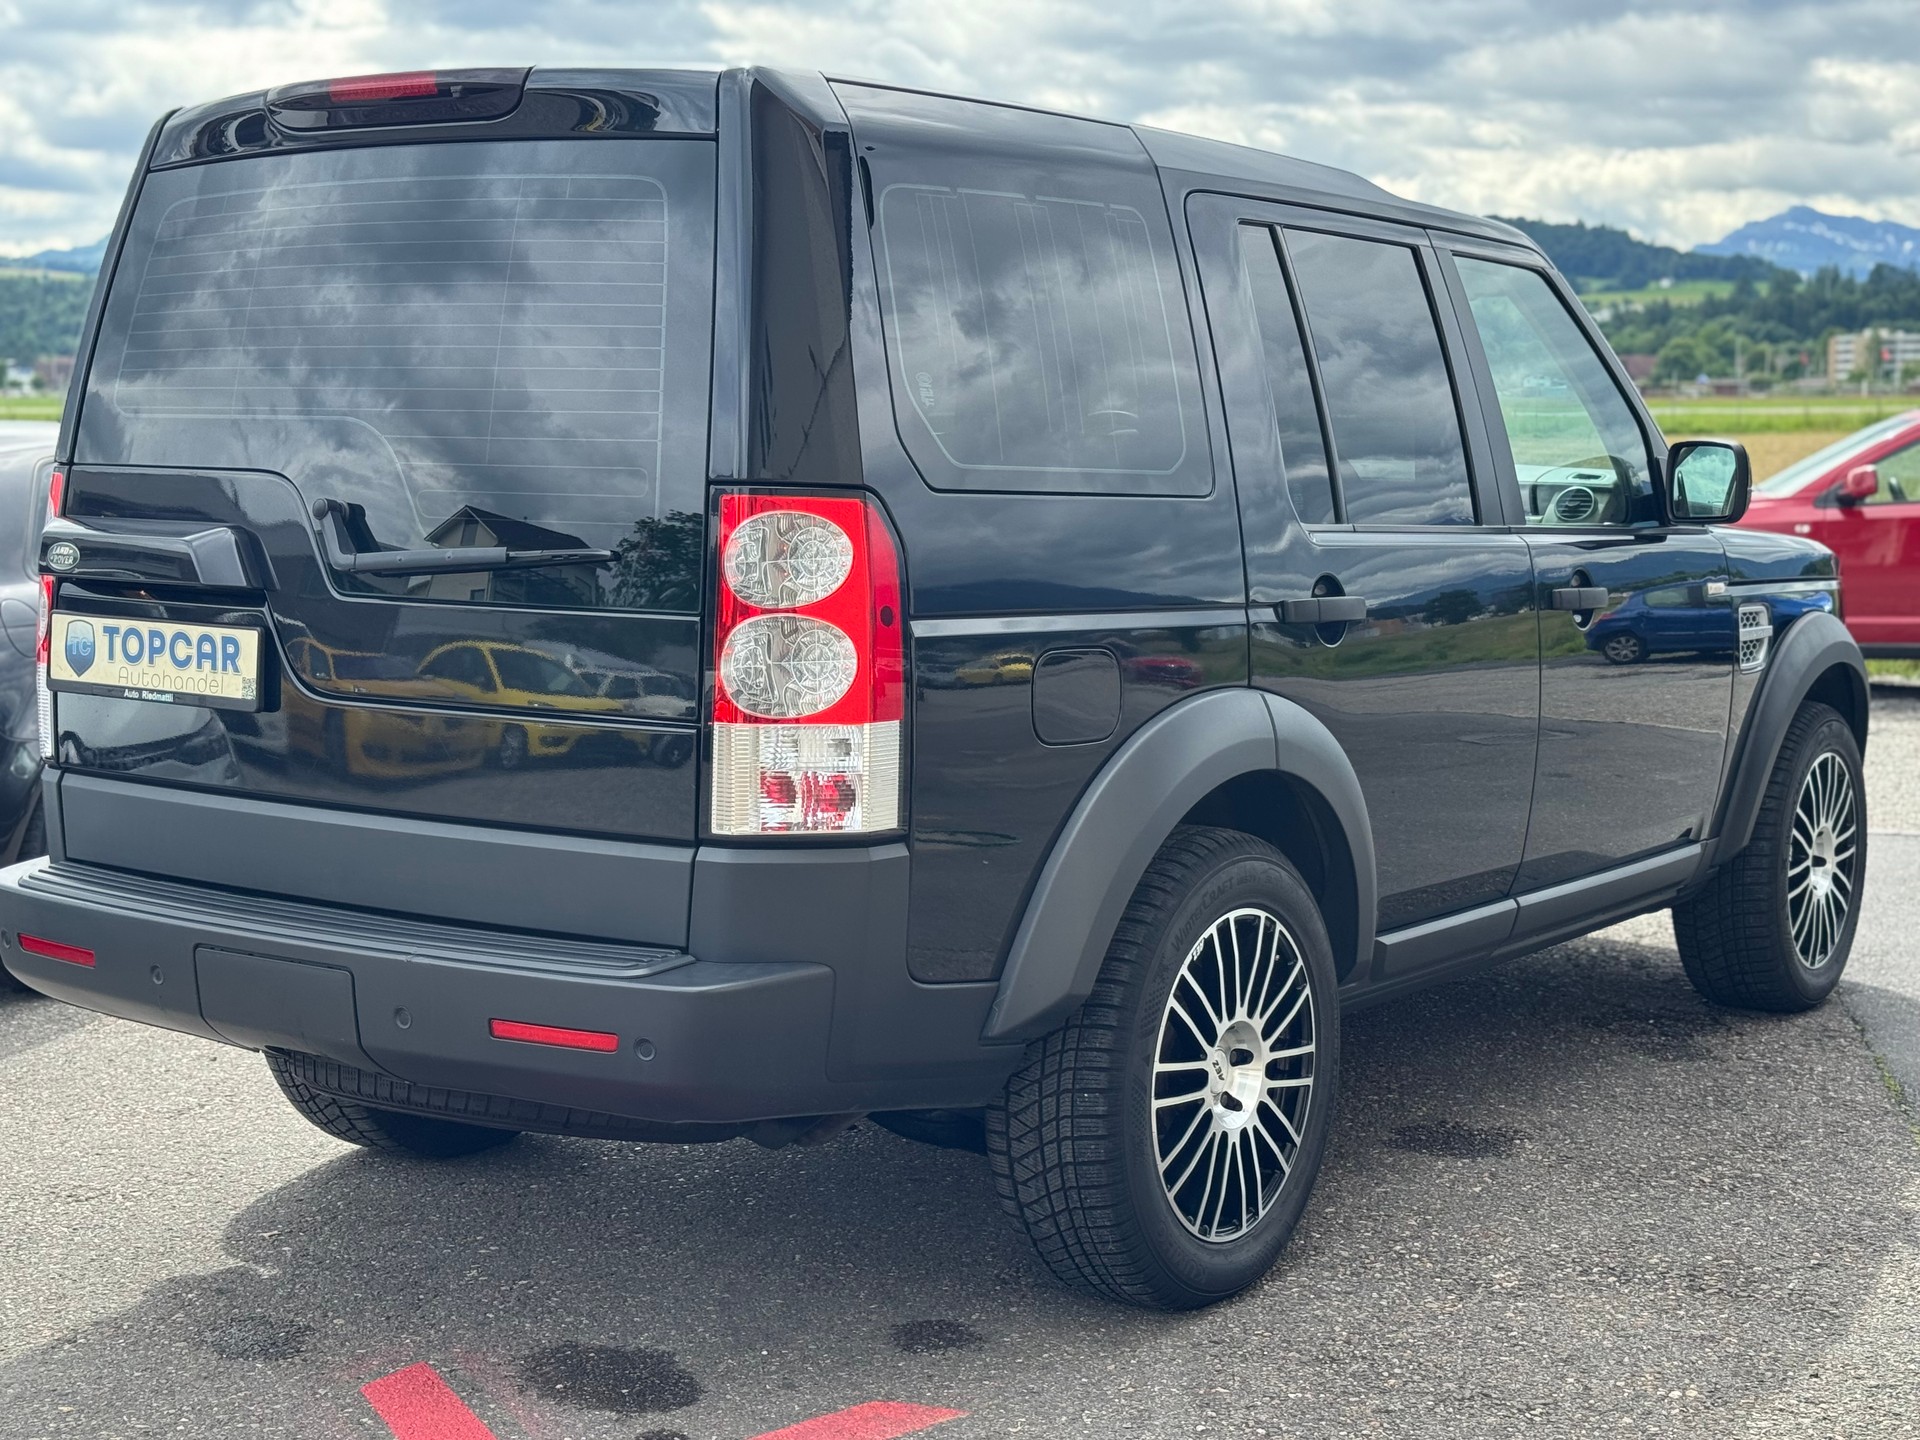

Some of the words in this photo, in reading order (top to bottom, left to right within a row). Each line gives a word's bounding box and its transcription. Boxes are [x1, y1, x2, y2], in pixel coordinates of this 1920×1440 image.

[52, 545, 70, 555] LAND
[53, 554, 74, 565] ROVER
[71, 638, 91, 656] TC
[103, 625, 240, 674] TOPCAR
[118, 667, 224, 694] Autohandel
[123, 688, 140, 699] Auto
[1211, 1059, 1225, 1081] AEZ
